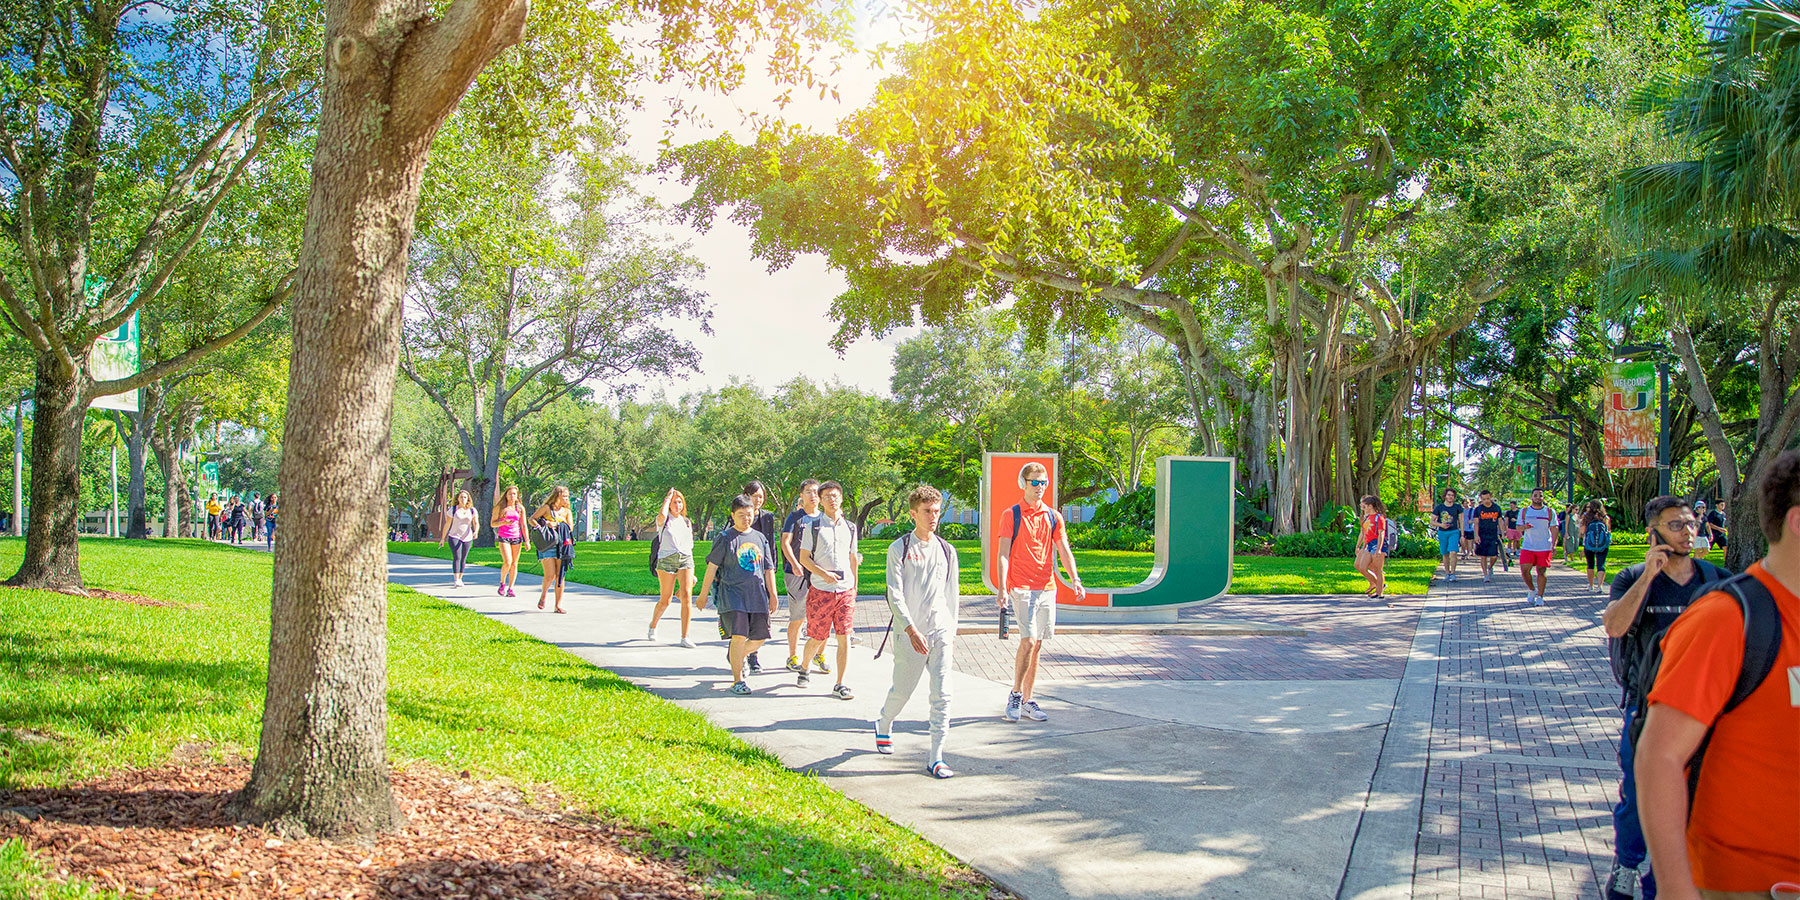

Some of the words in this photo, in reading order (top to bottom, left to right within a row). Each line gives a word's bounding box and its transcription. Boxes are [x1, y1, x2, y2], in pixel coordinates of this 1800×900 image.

[1612, 378, 1646, 388] WELCOME
[1611, 391, 1648, 412] U
[981, 453, 1235, 610] U
